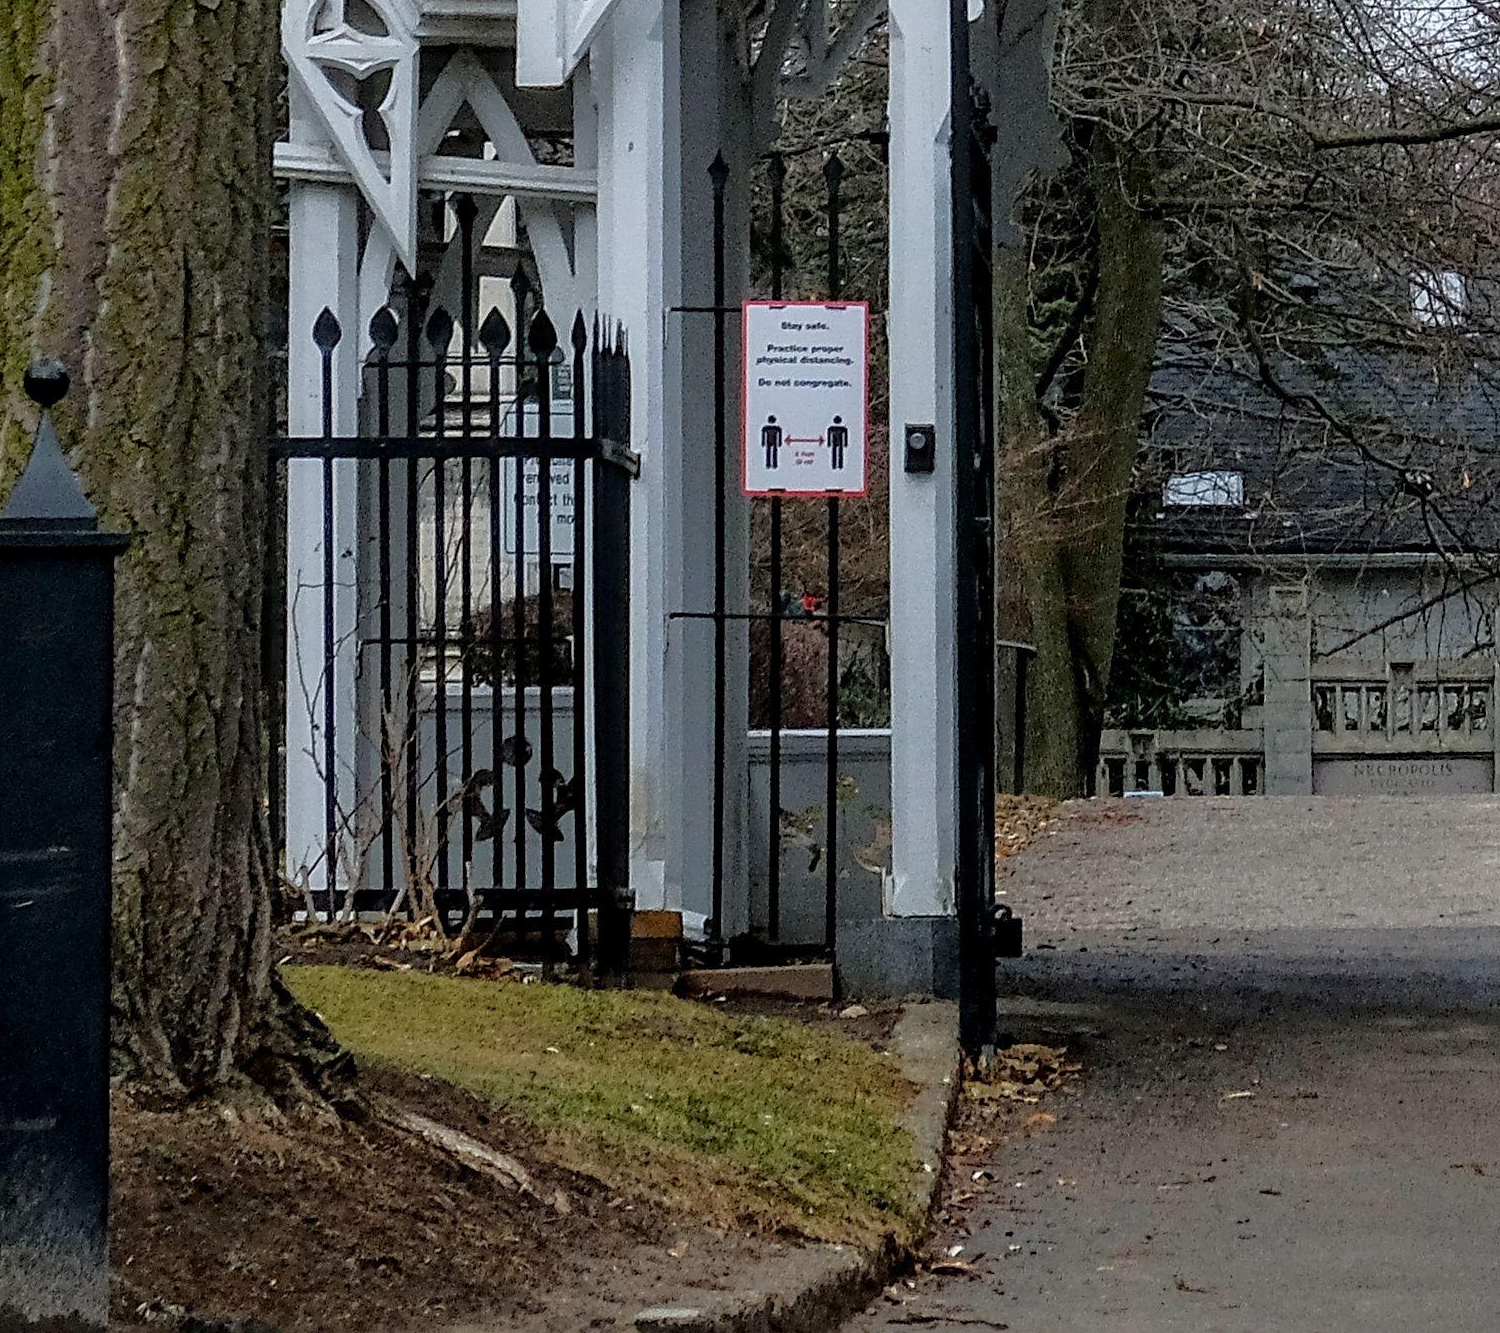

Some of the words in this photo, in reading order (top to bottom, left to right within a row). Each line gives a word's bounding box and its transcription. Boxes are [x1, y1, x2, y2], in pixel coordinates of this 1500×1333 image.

[781, 322, 802, 331] Stay
[805, 322, 830, 331] safe.
[767, 344, 808, 353] Practice
[811, 346, 844, 354] proper
[756, 356, 797, 365] physical
[758, 378, 772, 387] Do
[775, 379, 791, 387] not
[794, 380, 852, 388] congregate.
